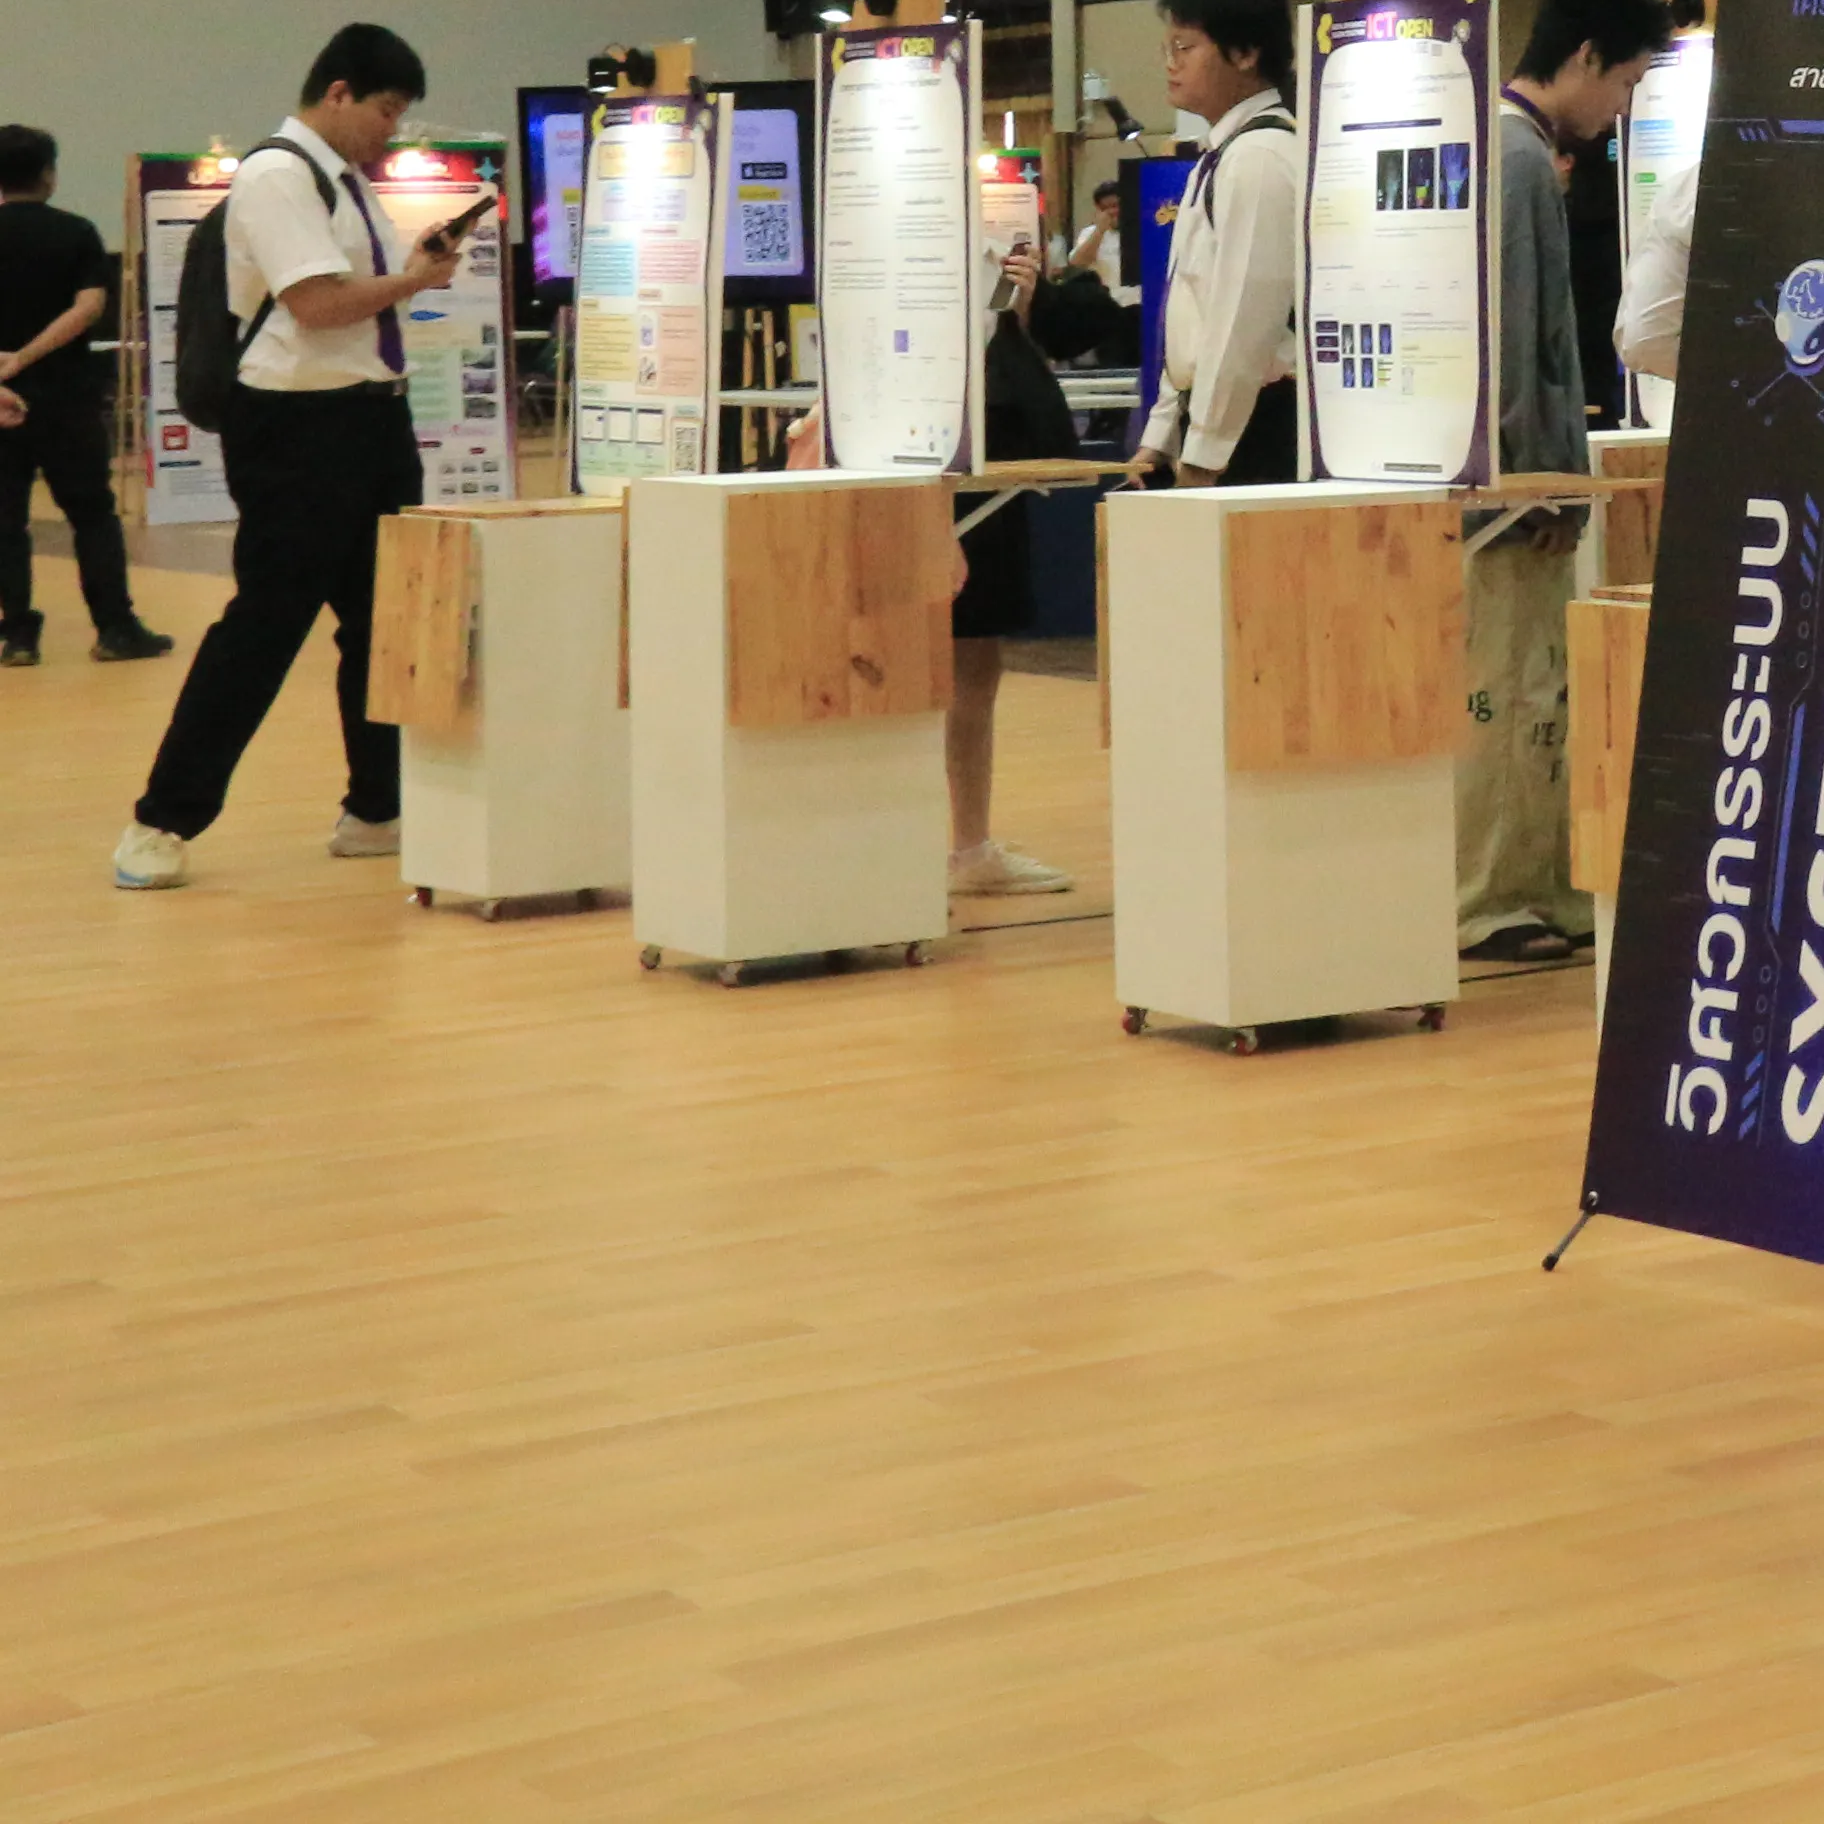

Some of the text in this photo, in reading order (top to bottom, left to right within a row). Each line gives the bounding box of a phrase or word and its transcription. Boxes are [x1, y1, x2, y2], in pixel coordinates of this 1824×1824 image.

[1366, 11, 1398, 40] ICT
[1665, 498, 1789, 1135] วิศวกรระบบ
